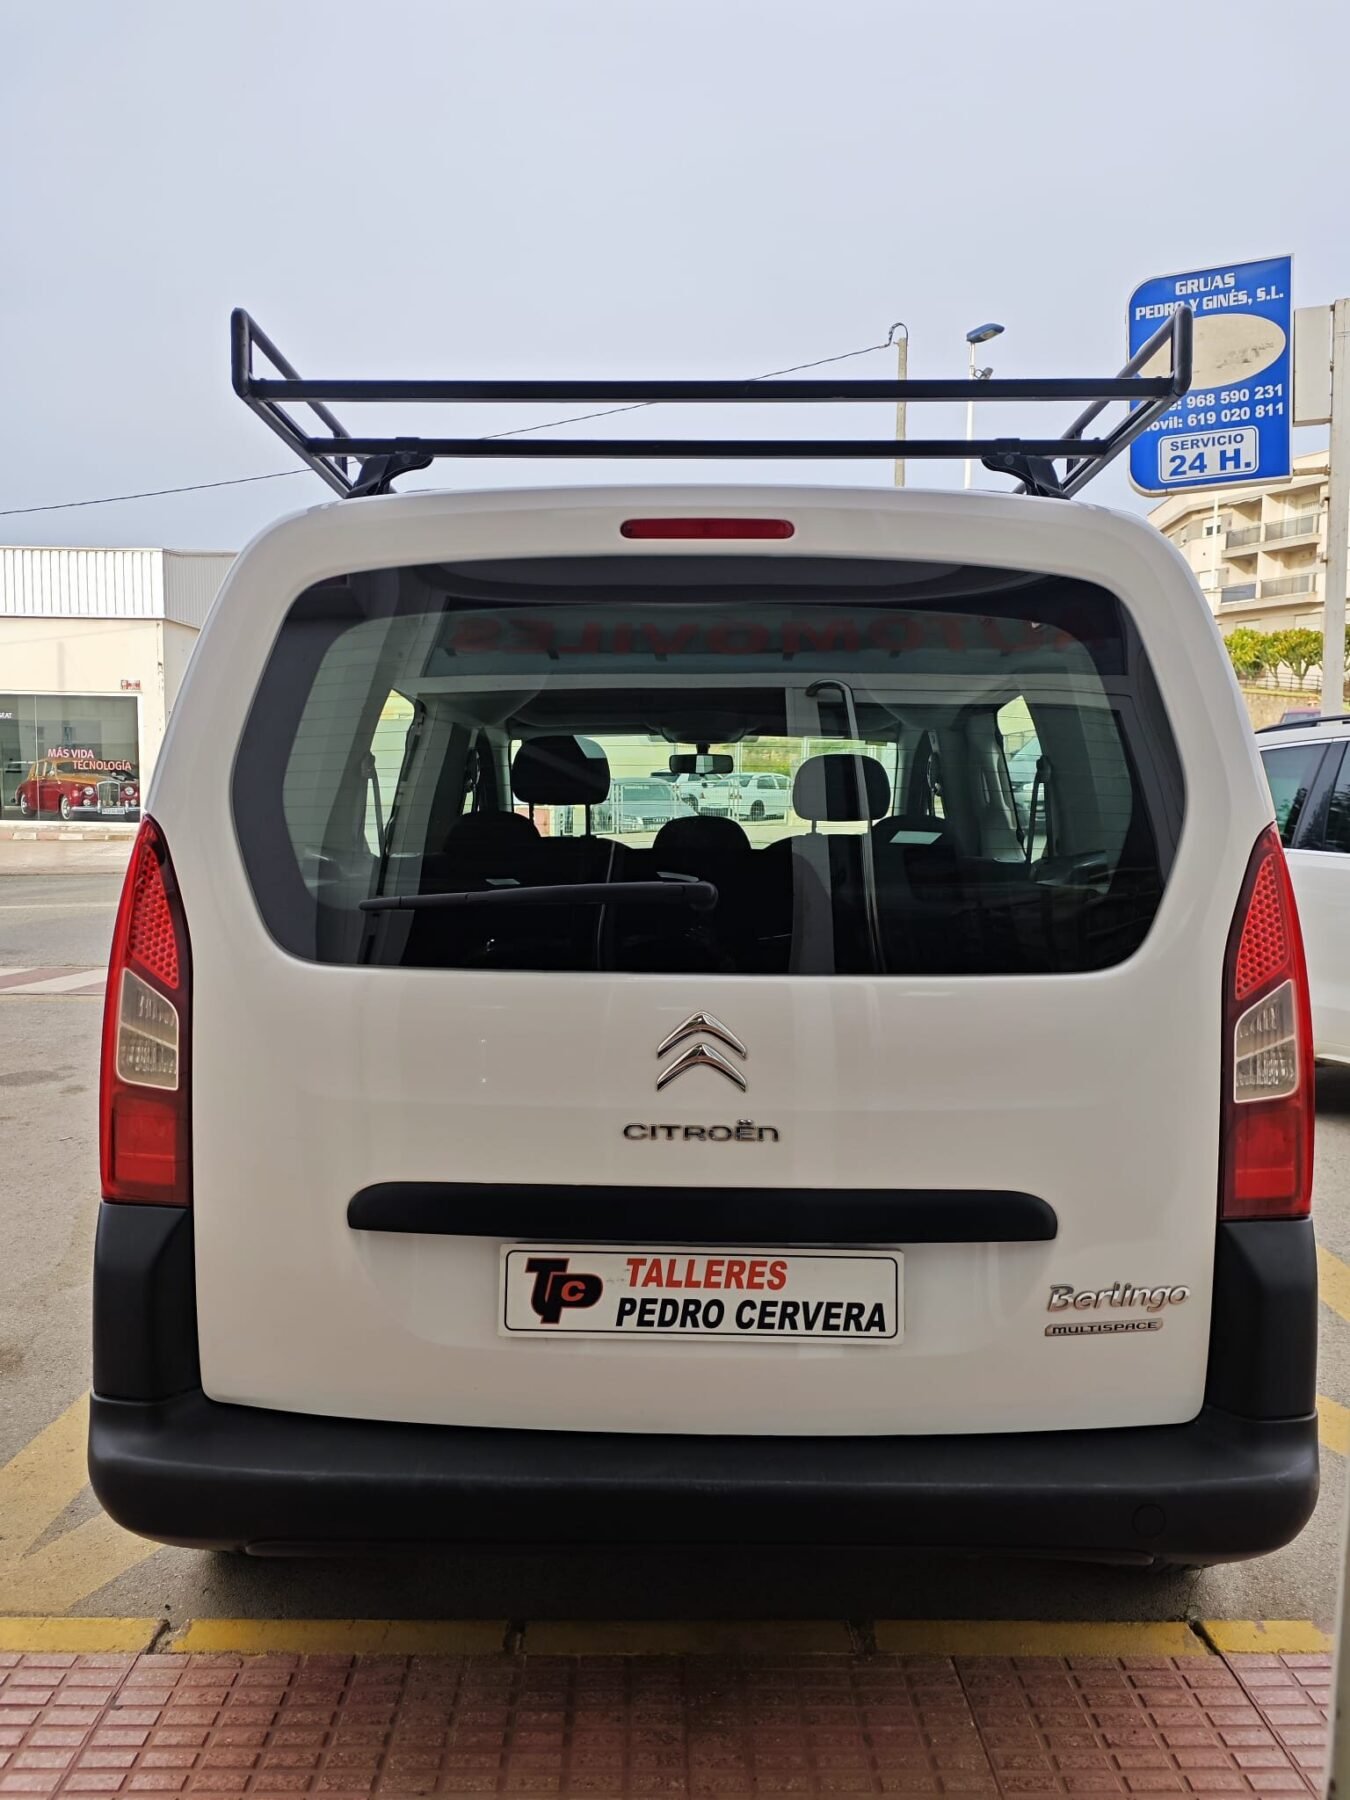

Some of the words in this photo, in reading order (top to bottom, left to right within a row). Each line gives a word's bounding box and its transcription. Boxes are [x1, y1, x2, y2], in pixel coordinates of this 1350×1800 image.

[1175, 272, 1235, 296] GRUAS
[1135, 300, 1185, 320] PEDRO
[1189, 297, 1200, 312] Y
[1202, 289, 1253, 310] GINÉS,
[1256, 285, 1284, 302] S.L.
[1186, 393, 1215, 409] 968
[1220, 388, 1250, 405] 590
[1254, 383, 1283, 400] 231
[1146, 415, 1183, 432] ovil:
[1187, 411, 1217, 427] 619
[1221, 406, 1251, 423] 020
[1255, 401, 1284, 418] 811
[1170, 433, 1245, 452] SERVICIO
[1169, 451, 1208, 478] 24
[1219, 447, 1252, 473] H.
[47, 746, 70, 759] MÁS
[71, 748, 95, 759] VIDA
[626, 1257, 788, 1290] TALLERES
[1047, 1281, 1190, 1312] Berlingo
[615, 1297, 725, 1329] PEDRO
[734, 1299, 887, 1333] CERVERA
[1052, 1321, 1158, 1335] MULTISPACE
